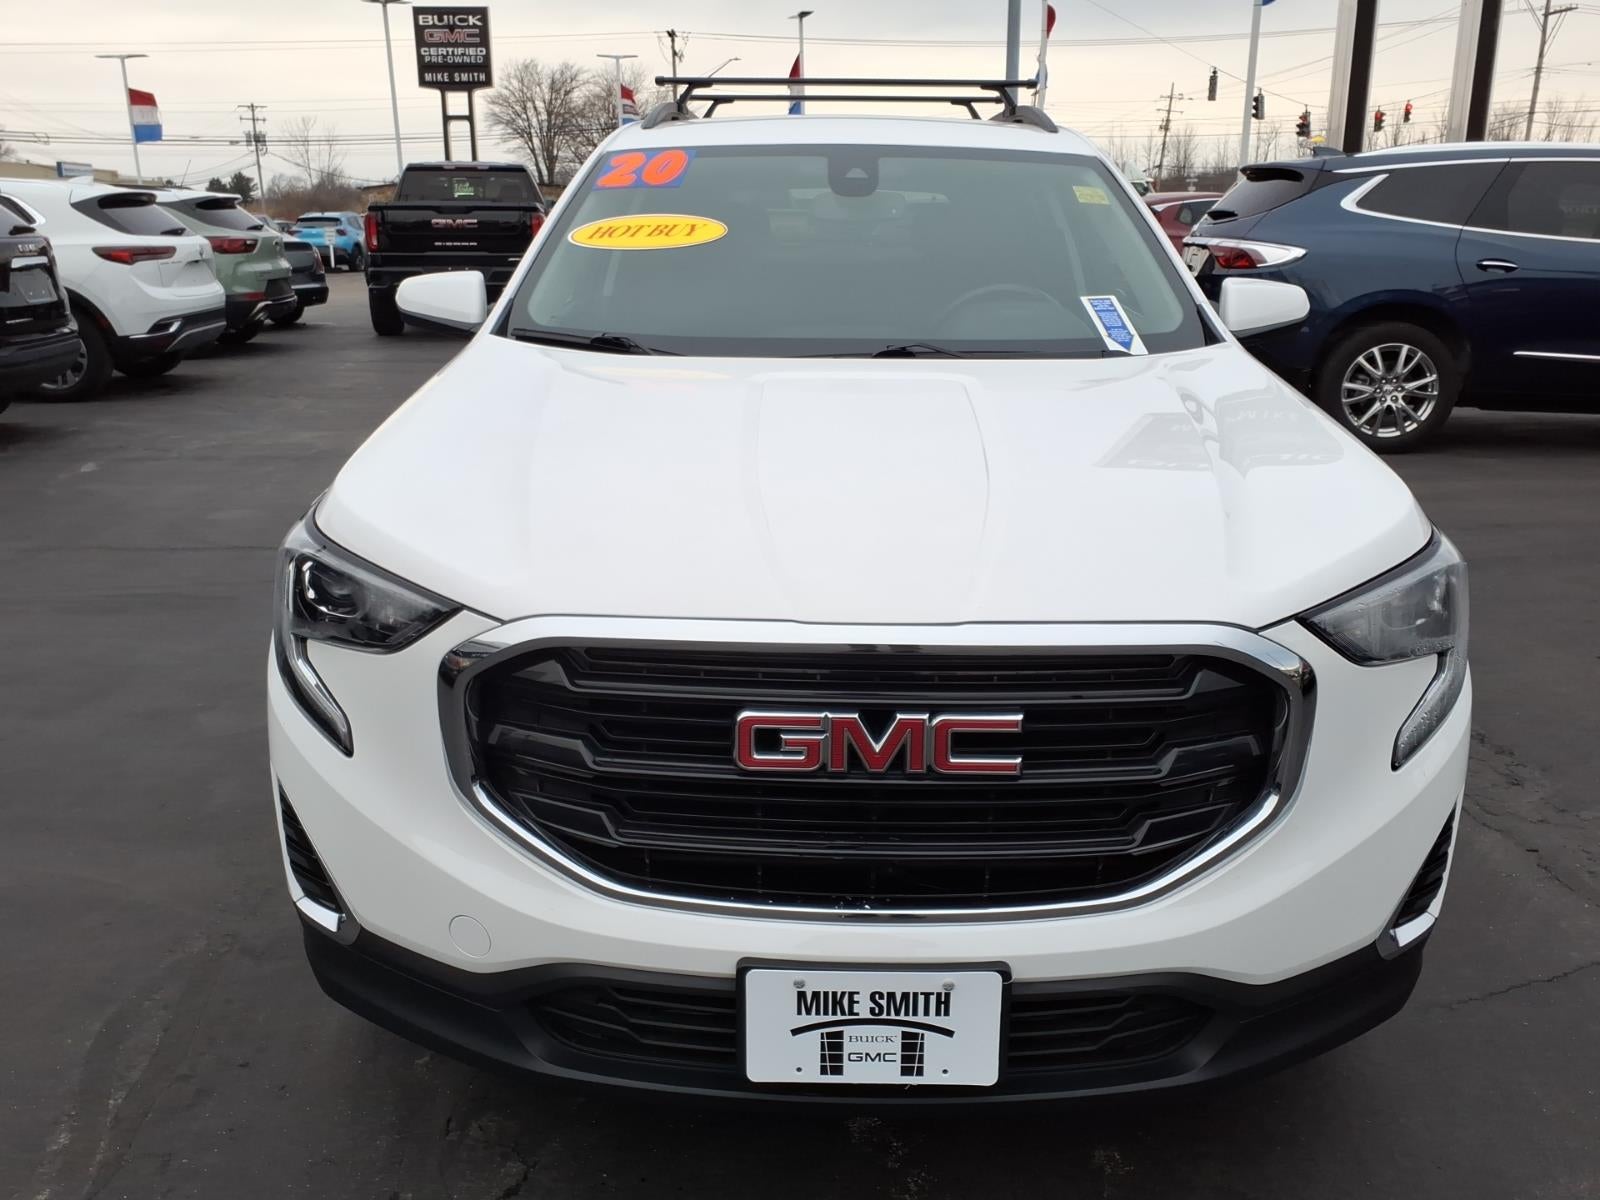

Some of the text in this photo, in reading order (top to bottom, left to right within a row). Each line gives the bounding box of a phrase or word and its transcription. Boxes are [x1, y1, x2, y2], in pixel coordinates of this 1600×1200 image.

[418, 14, 483, 26] BUICK
[424, 28, 480, 43] GMC
[420, 47, 486, 56] CERTIFIED
[424, 55, 484, 63] PRE-OWNED
[424, 72, 486, 82] MIKE SMITH
[596, 149, 689, 188] 20
[431, 218, 478, 228] GMC
[586, 223, 708, 240] HOT BUY
[734, 711, 1024, 776] GMC
[796, 990, 952, 1018] MIKE SMITH
[848, 1035, 897, 1044] BUICK
[847, 1052, 897, 1063] GMC
